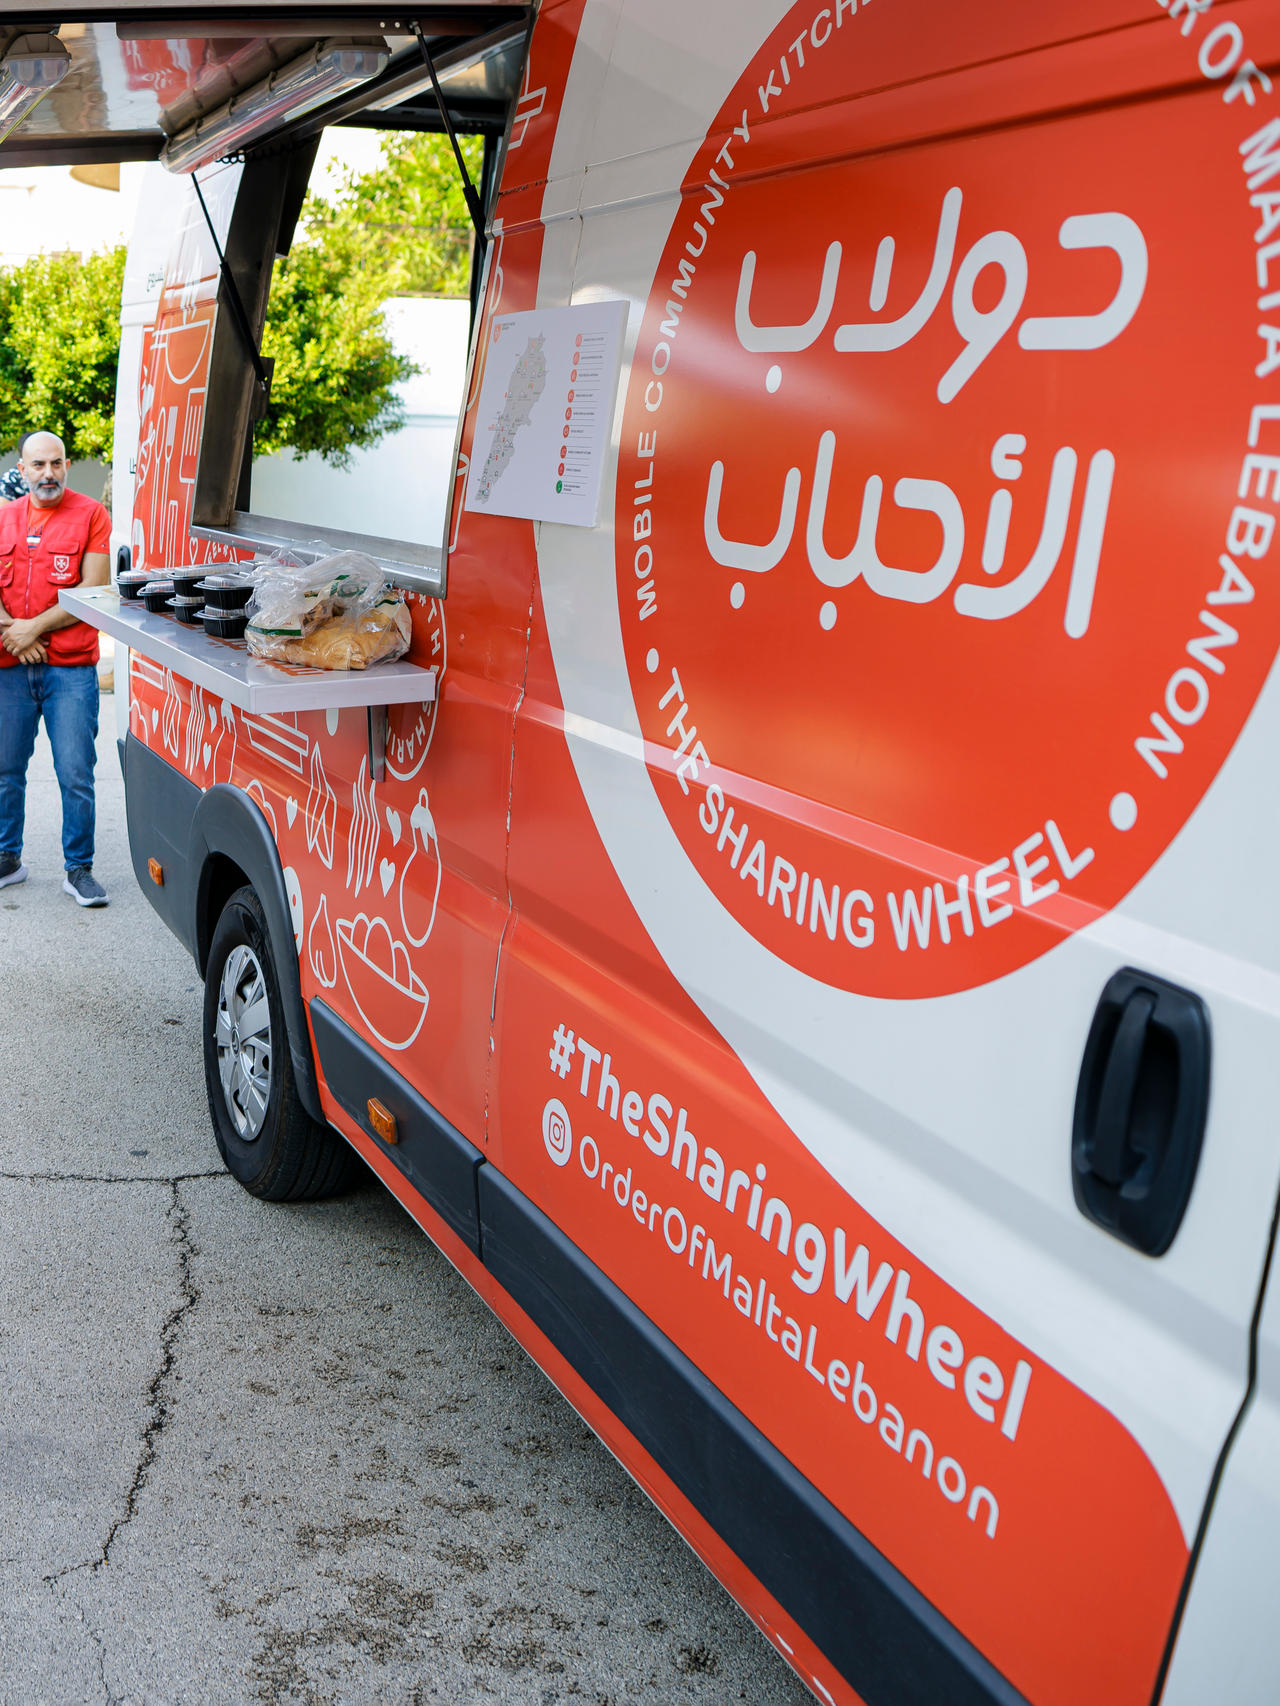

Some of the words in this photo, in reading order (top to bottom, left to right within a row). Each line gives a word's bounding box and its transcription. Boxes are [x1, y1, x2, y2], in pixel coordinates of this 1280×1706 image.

[758, 0, 877, 112] KITCH
[1197, 21, 1273, 106] OF
[643, 109, 750, 414] COMMUNITY
[734, 187, 1149, 404] دولاب
[634, 429, 658, 621] MOBILE
[703, 429, 1116, 639] الأحباب
[1134, 404, 1280, 780] LEBANON
[657, 668, 712, 797] THE
[698, 784, 875, 949] SHARING
[886, 819, 1096, 952] WHEEL
[548, 1023, 1033, 1442] #TheSharingWheel
[579, 1135, 1000, 1540] OrderOfMaltaLebanon
